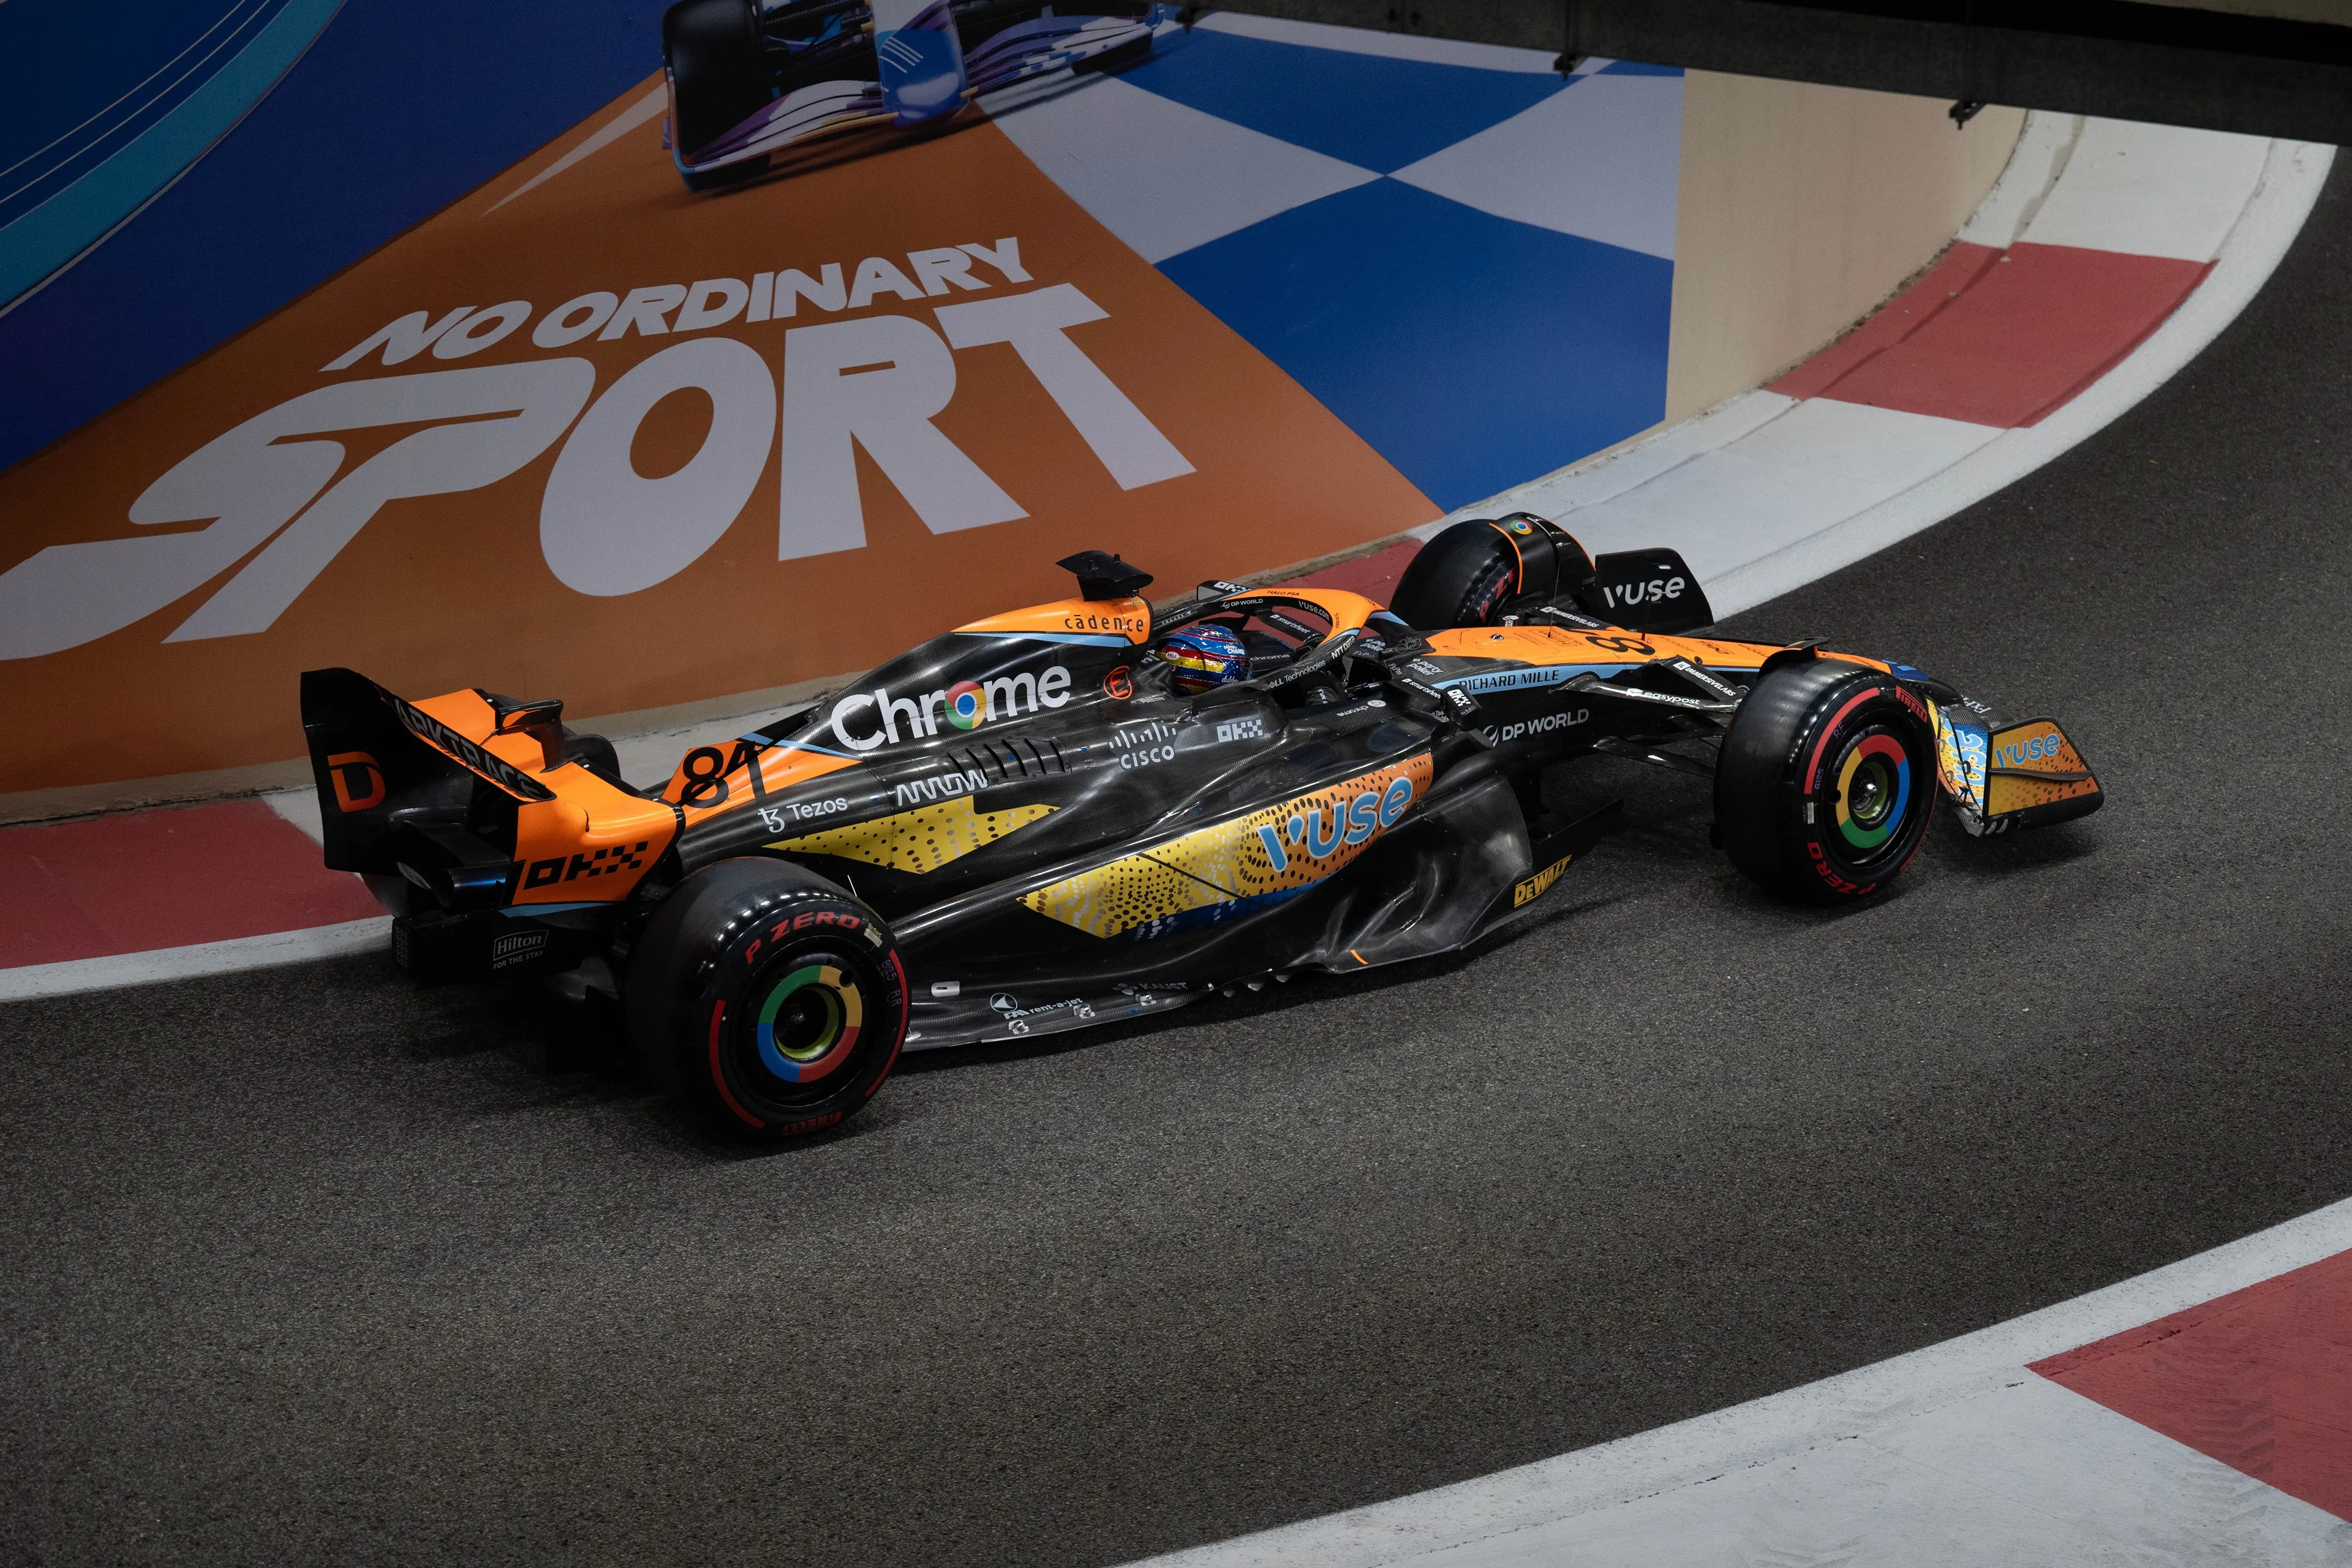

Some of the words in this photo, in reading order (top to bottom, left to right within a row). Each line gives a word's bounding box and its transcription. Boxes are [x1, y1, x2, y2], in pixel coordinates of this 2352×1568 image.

[318, 298, 532, 372] NO
[532, 235, 1033, 349] ORDINARY
[0, 281, 1197, 660] SPORT
[1276, 616, 1311, 634] smartsheet
[1331, 645, 1344, 660] NTT
[1283, 660, 1325, 682] Technologies
[1387, 663, 1403, 675] FxPro
[1406, 663, 1435, 676] poker
[1417, 661, 1444, 674] party
[1458, 674, 1516, 690] RICHARD
[1520, 669, 1559, 685] MILLE
[1684, 667, 1736, 696] IMMERSIVELABS
[1643, 691, 1700, 705] easypost
[1896, 685, 1928, 723] PIRELLI
[1502, 723, 1525, 742] DP
[1528, 708, 1589, 736] WORLD
[786, 796, 848, 820] Tezos
[1807, 842, 1860, 895] ZERO
[497, 934, 542, 955] Hilton
[745, 940, 762, 964] P
[771, 911, 861, 943] ZERO
[493, 960, 507, 970] FOR
[508, 955, 524, 965] THE
[525, 950, 545, 960] STAY
[1030, 997, 1084, 1014] rent-a-jet
